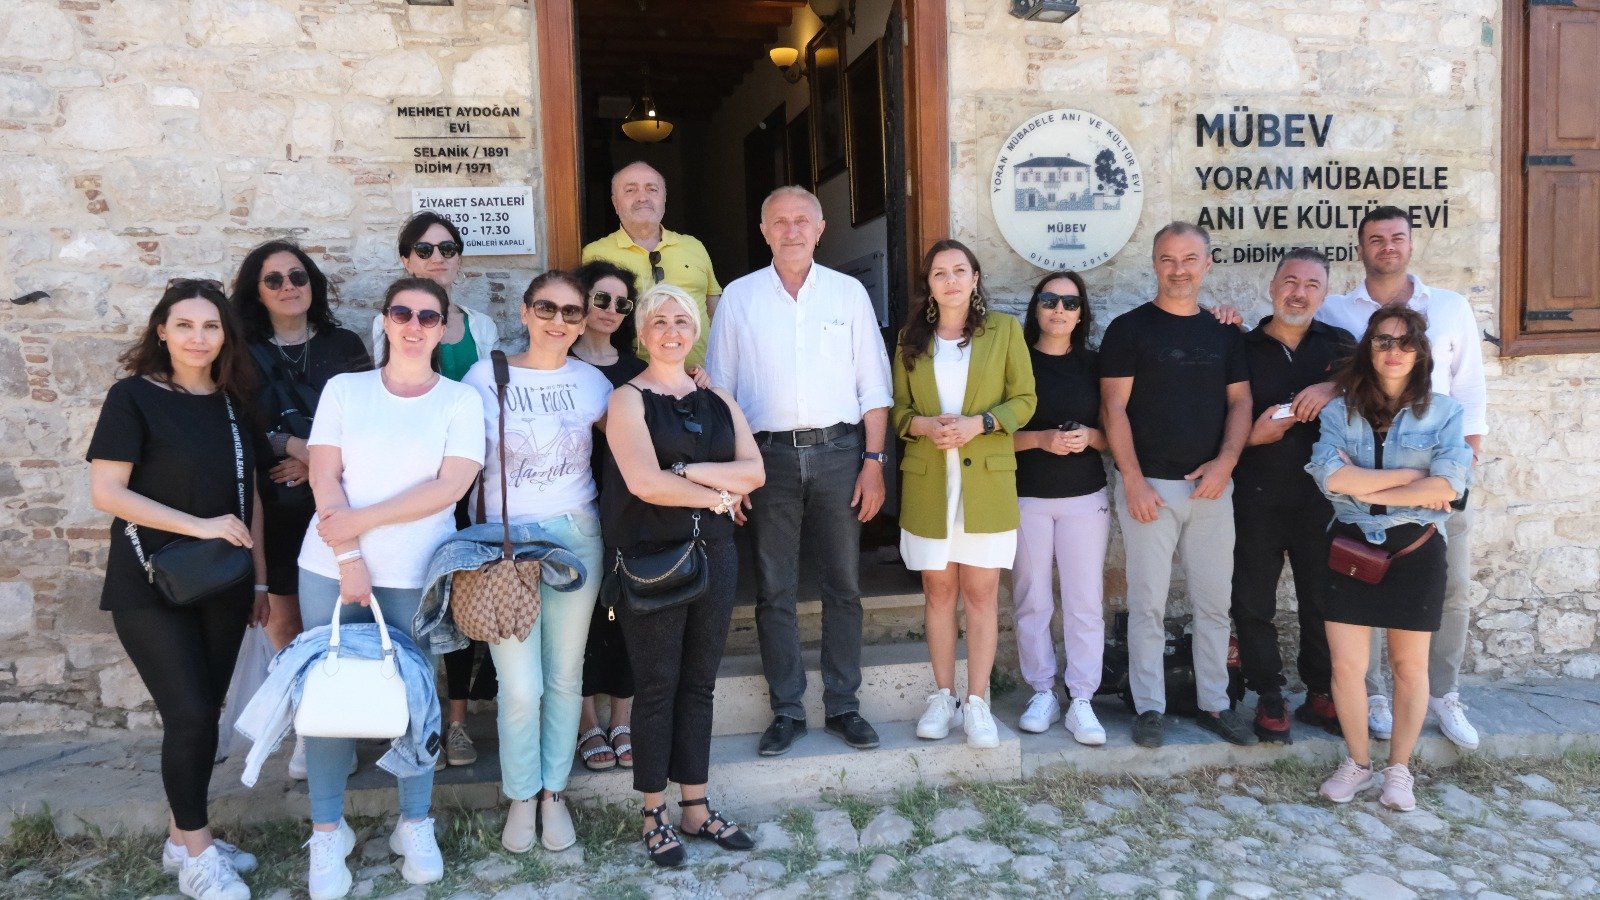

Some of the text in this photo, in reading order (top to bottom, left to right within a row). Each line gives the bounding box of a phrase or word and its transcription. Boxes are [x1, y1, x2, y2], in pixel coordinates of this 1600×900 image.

[397, 105, 520, 117] MEHMET AYDOĞAN
[450, 121, 470, 133] EVİ
[1196, 106, 1334, 147] MÜBEV
[413, 145, 509, 158] SELANİK / 1891
[993, 156, 1008, 193] YORAN
[1007, 115, 1055, 152] MÜBADELE
[1061, 113, 1081, 121] ANI
[1089, 118, 1102, 129] VE
[1106, 129, 1135, 167] KÜLTÜR
[415, 162, 492, 174] DİDİM / 1971
[1195, 161, 1449, 190] YORAN MÜBADELE
[419, 195, 525, 208] ZİYARET SAATLERİ
[480, 213, 509, 222] 12.30
[1197, 200, 1449, 230] ANI VE KÜLT EVİ
[480, 226, 510, 235] 17.30
[1047, 222, 1087, 233] MÜBEV
[466, 239, 497, 247] GÜNLERİ
[1082, 252, 1109, 267] 2018
[1233, 244, 1285, 263] DİDİM
[541, 389, 575, 412] MOST
